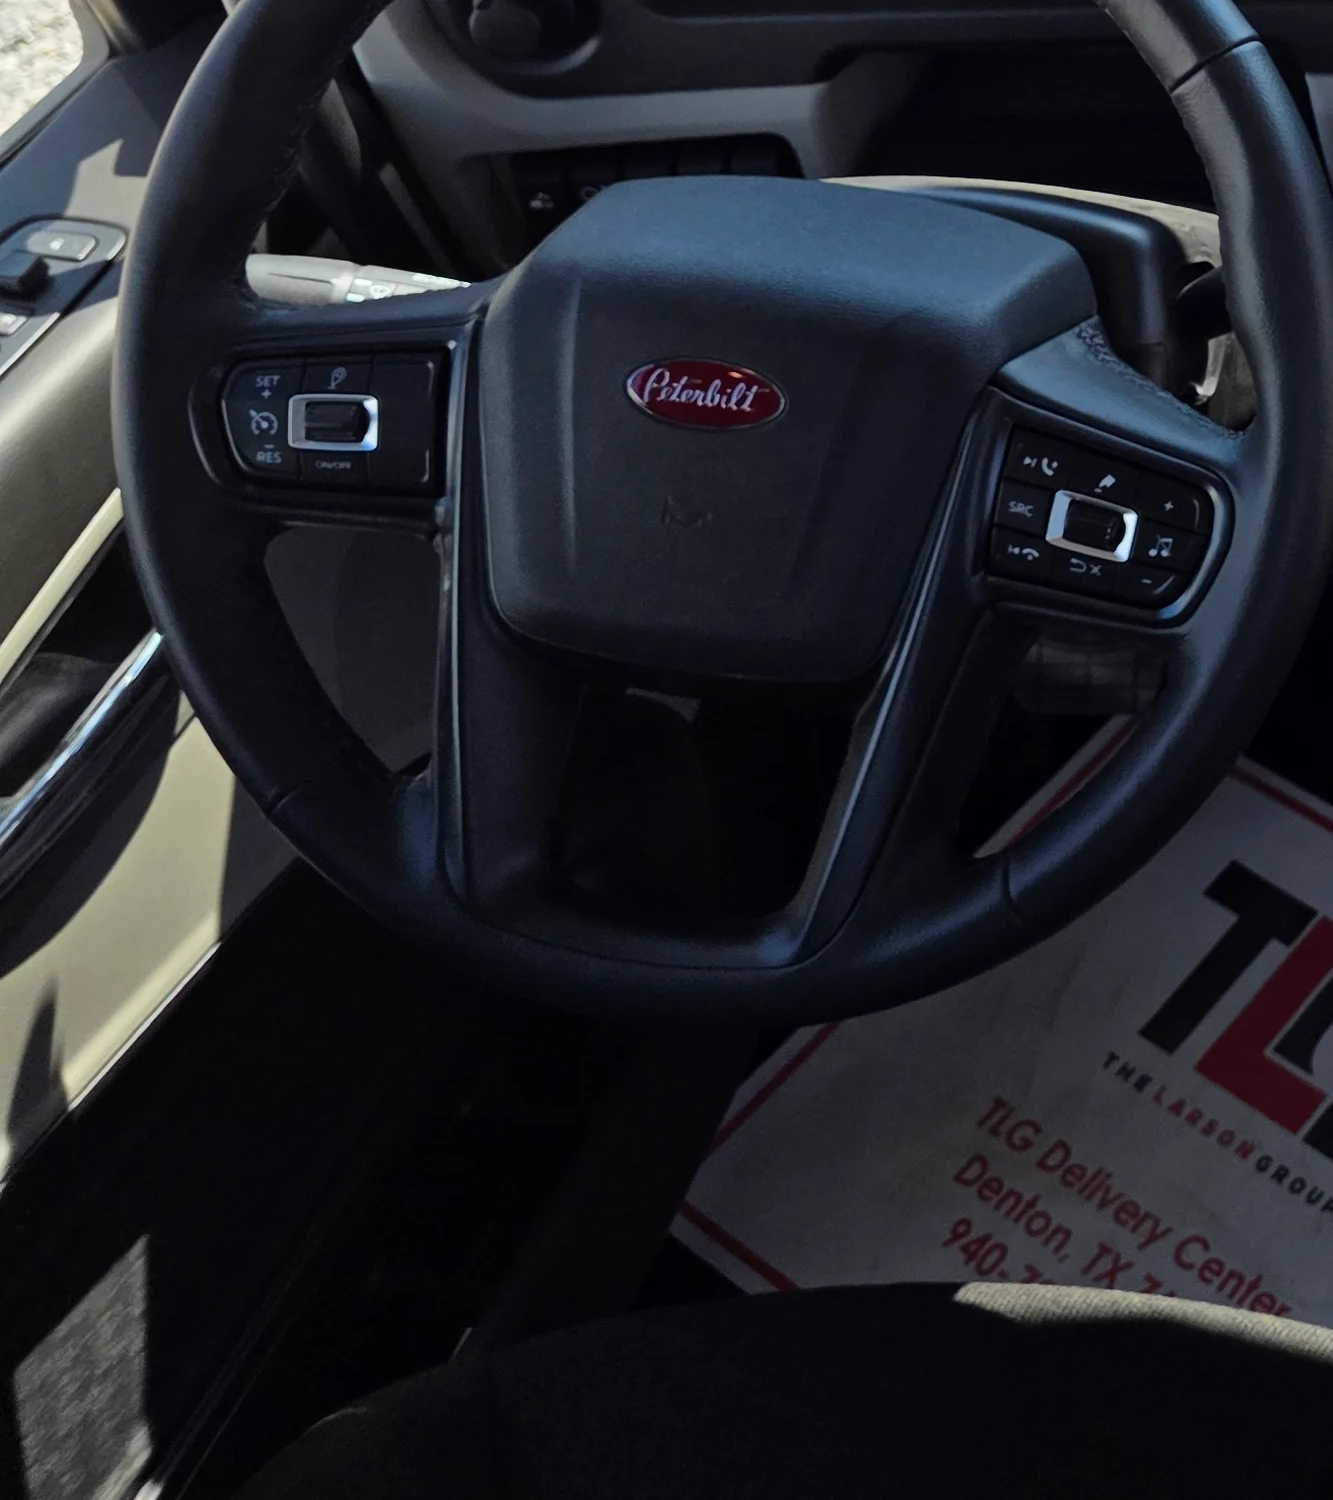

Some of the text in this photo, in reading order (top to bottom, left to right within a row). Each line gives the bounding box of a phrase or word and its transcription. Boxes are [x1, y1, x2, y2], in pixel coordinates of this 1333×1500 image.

[255, 375, 281, 389] SET
[642, 366, 770, 412] Peterbilt
[256, 451, 283, 465] RES
[1008, 500, 1035, 519] SRC
[1101, 1051, 1154, 1096] THE
[1153, 1085, 1257, 1161] LARSON
[953, 1152, 1136, 1290] Denton, TX
[977, 1096, 1293, 1317] TLG Delivery Center
